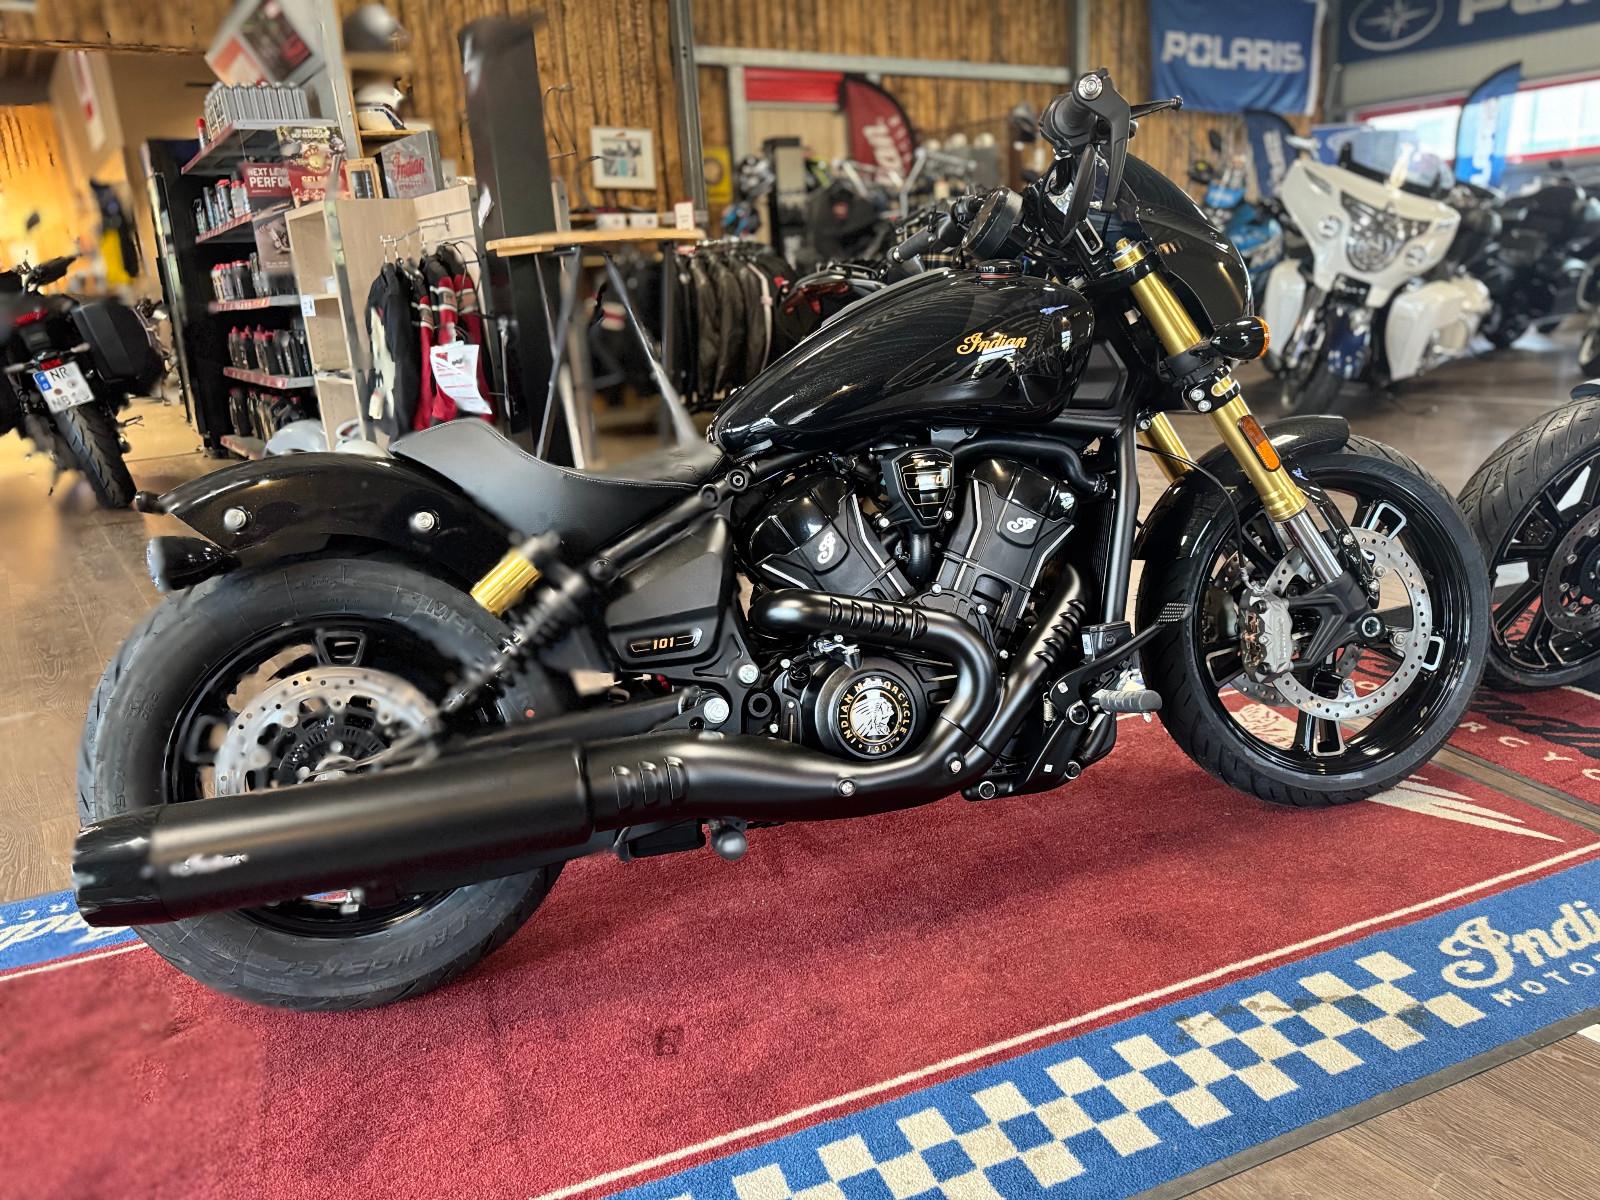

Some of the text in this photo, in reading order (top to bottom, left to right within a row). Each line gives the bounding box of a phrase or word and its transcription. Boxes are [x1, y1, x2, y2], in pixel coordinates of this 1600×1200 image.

[1161, 29, 1306, 74] POLARIS
[247, 167, 268, 177] NEXT
[956, 331, 1028, 355] Indian
[653, 637, 675, 650] 101
[840, 693, 857, 744] INDIAN
[866, 741, 894, 753] 1901
